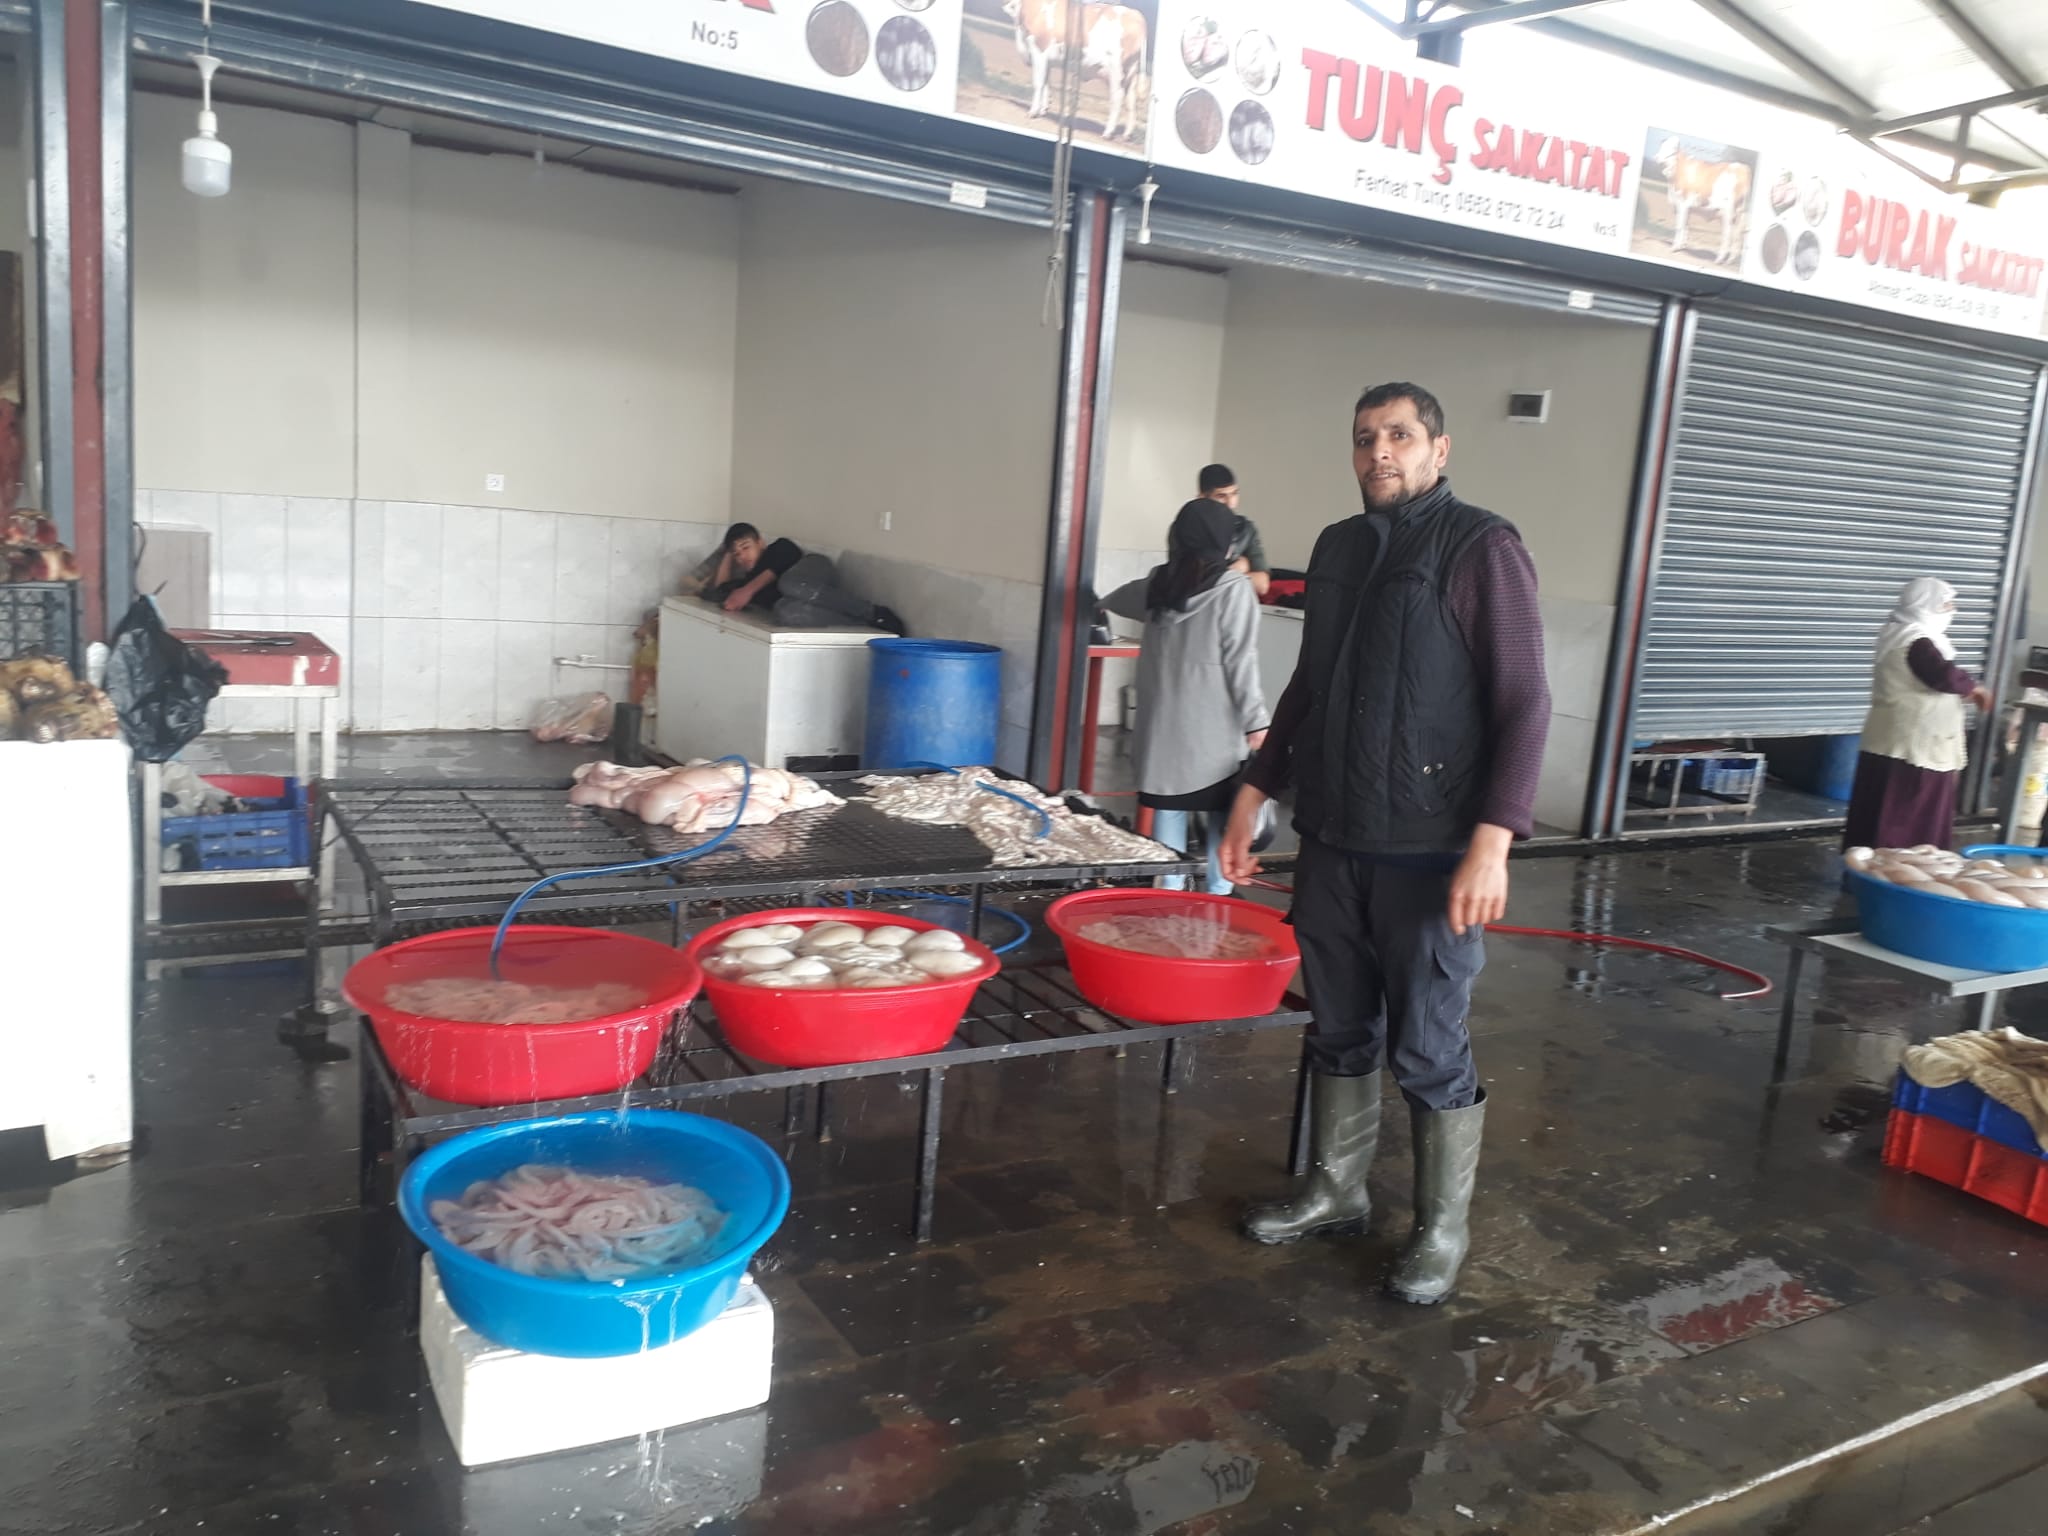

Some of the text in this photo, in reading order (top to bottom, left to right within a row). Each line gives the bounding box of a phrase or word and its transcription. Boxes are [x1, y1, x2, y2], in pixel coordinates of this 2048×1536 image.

[692, 21, 739, 50] No:5
[1302, 49, 1630, 198] TUNÇ SAKATAT
[1413, 181, 1451, 213] Tunç
[1836, 189, 1957, 281] BURAK
